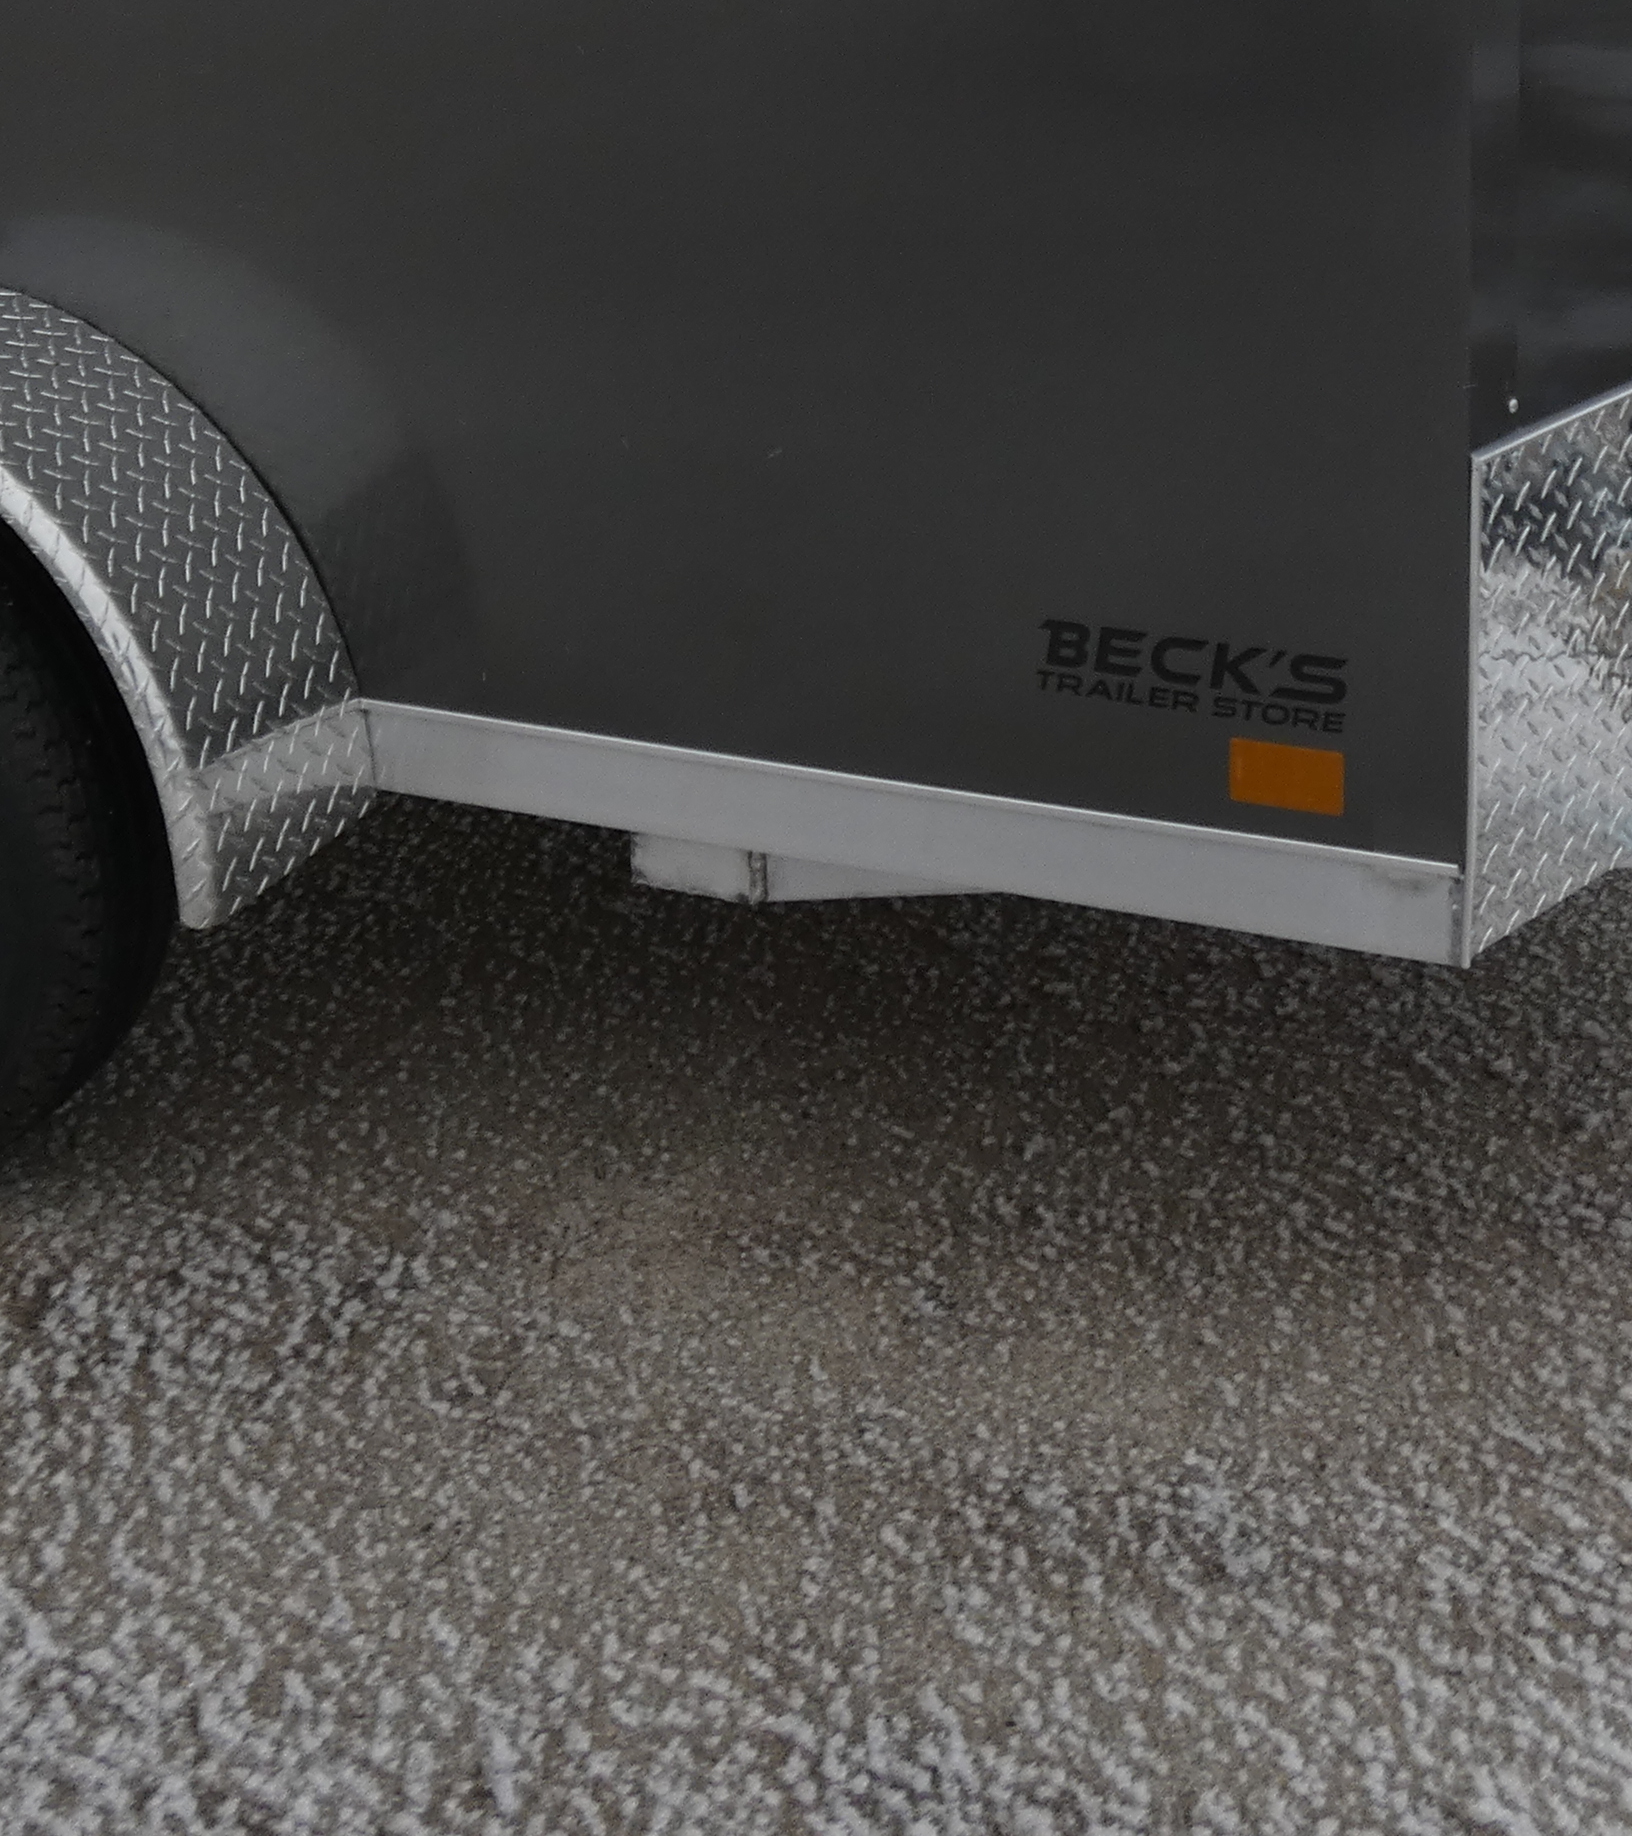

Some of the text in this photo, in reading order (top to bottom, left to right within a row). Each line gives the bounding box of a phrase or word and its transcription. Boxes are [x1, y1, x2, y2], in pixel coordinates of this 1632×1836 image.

[1037, 618, 1349, 705] BECK'S
[1035, 669, 1347, 734] TRAILER STORE
